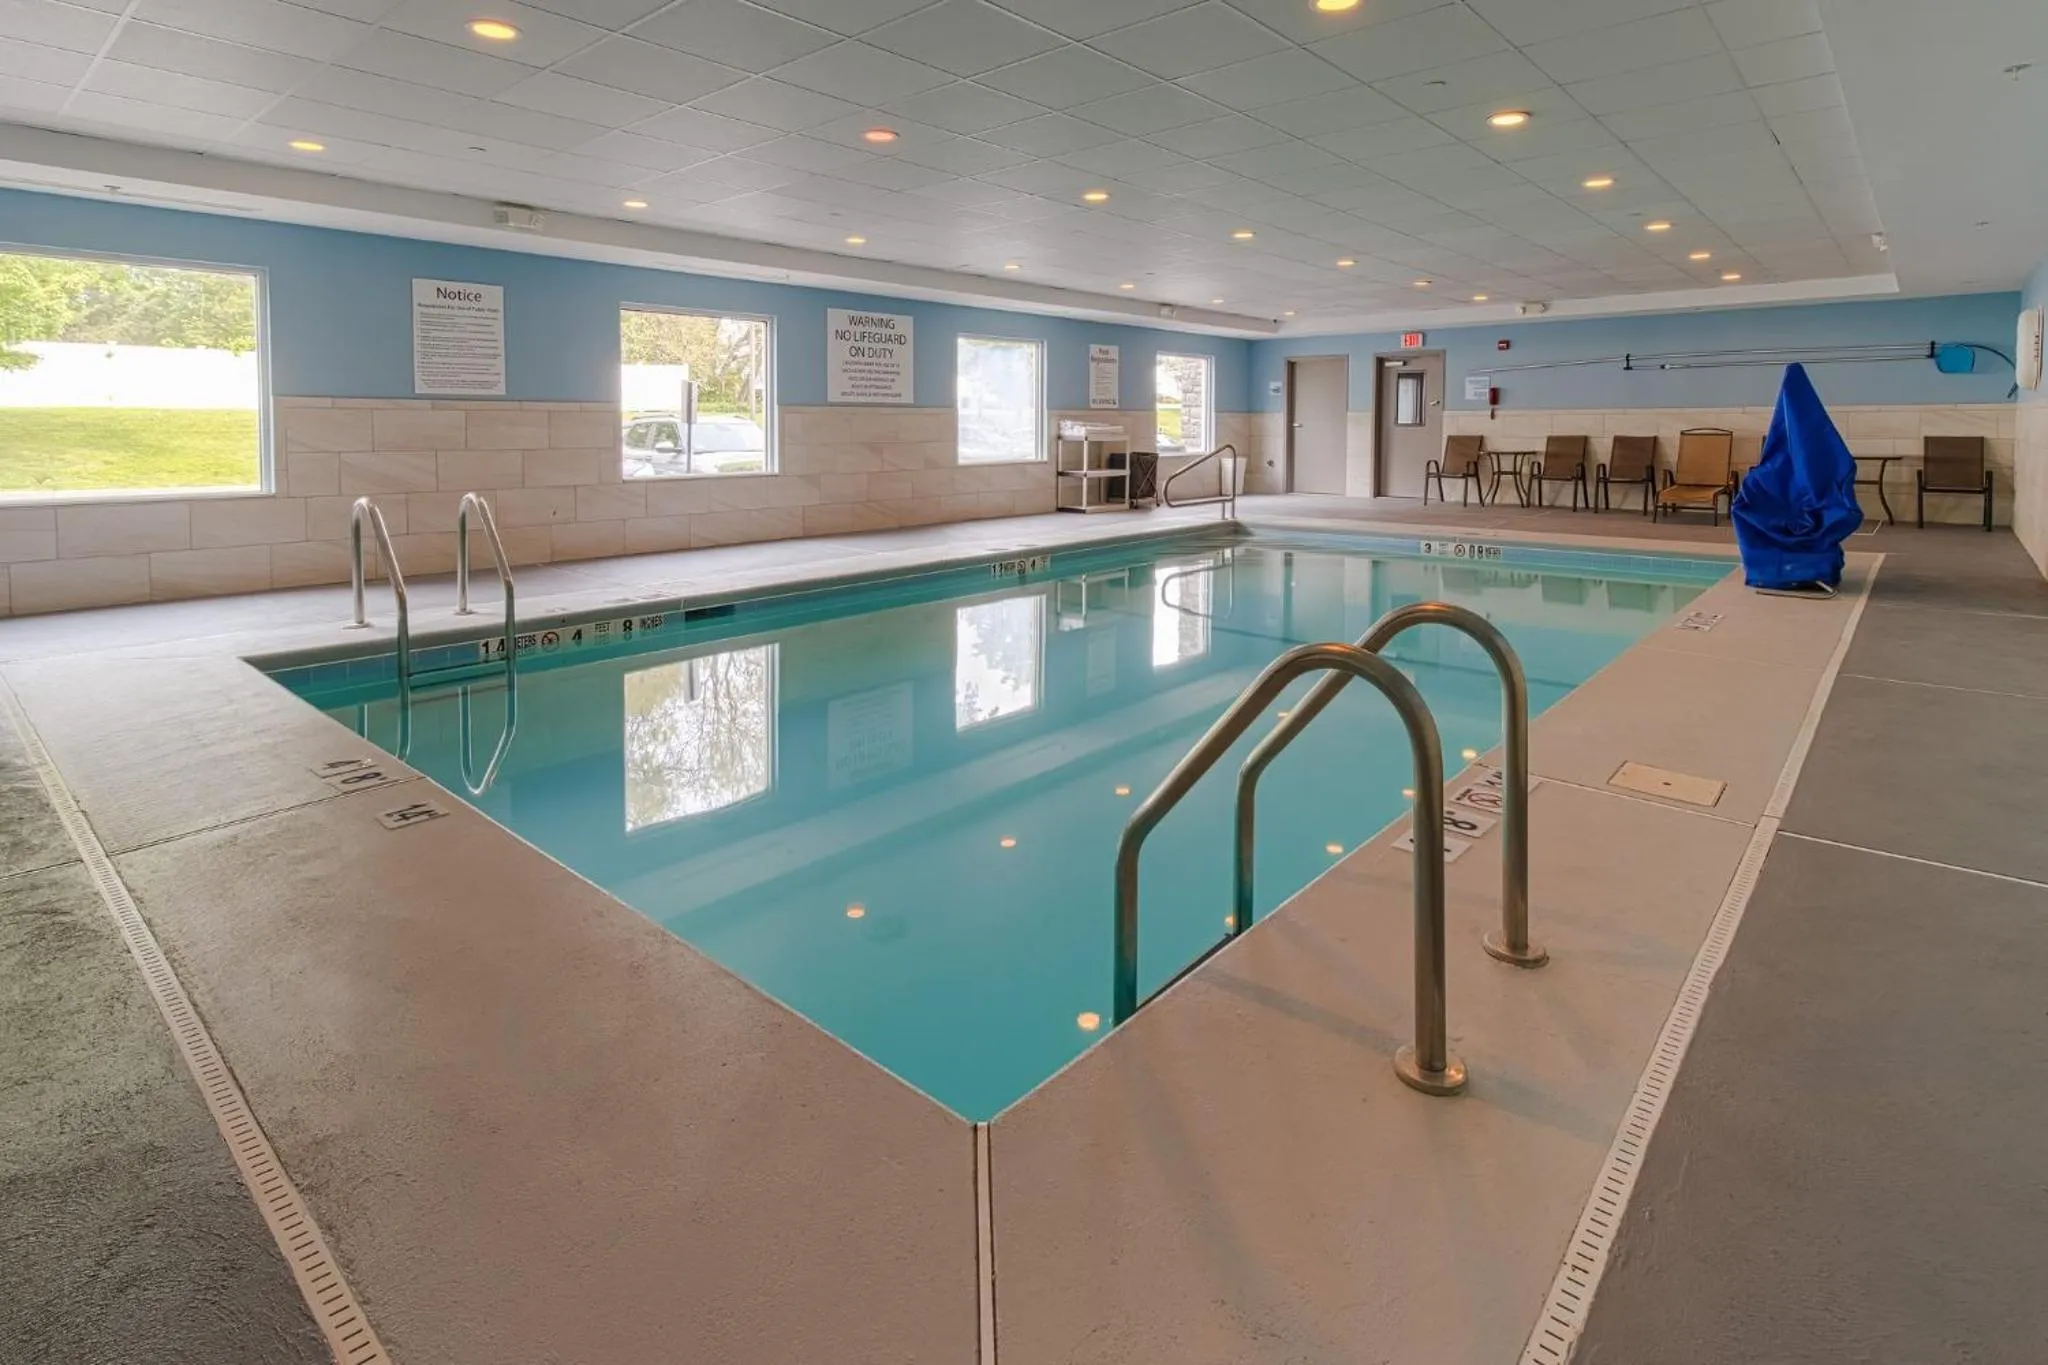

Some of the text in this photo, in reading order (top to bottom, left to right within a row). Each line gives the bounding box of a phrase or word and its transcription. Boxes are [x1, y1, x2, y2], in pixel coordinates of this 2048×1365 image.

[436, 287, 482, 302] Notice
[848, 315, 895, 329] WARNING
[835, 329, 907, 345] NO LIFEGUARD
[849, 345, 894, 358] ON DUTY
[595, 622, 611, 633] FEET
